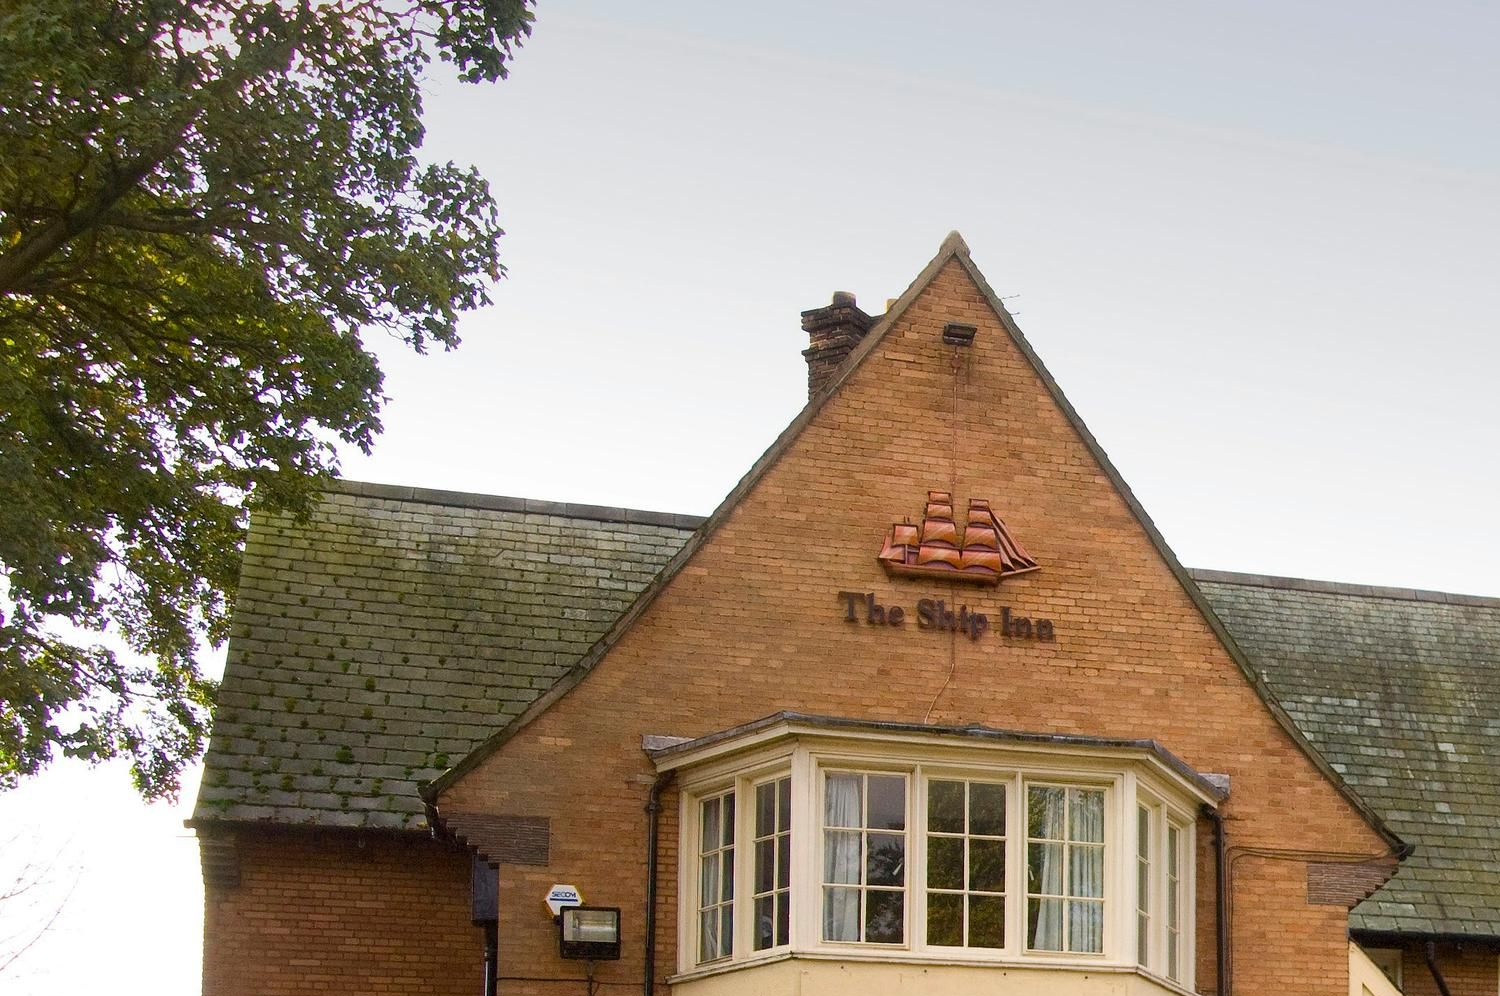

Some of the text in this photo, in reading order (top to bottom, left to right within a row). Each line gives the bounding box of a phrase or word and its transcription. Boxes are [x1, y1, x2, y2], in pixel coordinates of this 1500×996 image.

[838, 590, 1056, 643] The Ship Inn
